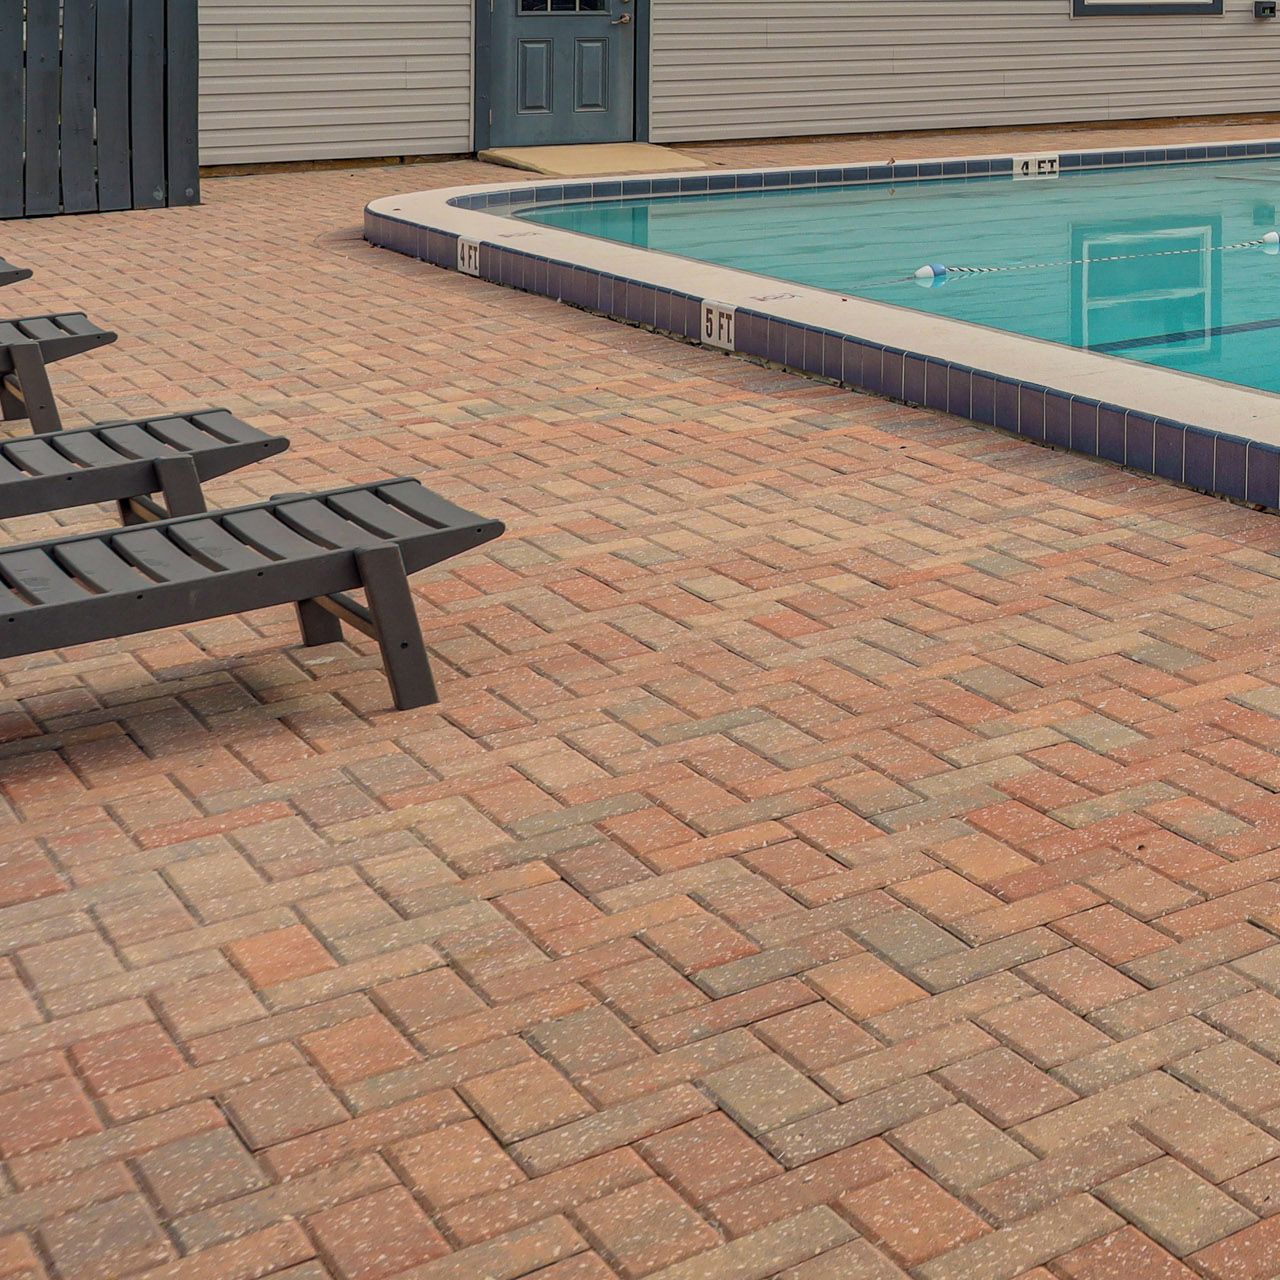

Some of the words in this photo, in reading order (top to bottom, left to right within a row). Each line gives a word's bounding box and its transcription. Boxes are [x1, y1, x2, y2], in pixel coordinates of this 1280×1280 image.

[460, 242, 466, 267] 4
[705, 308, 713, 338] 5
[718, 311, 733, 343] FT.
